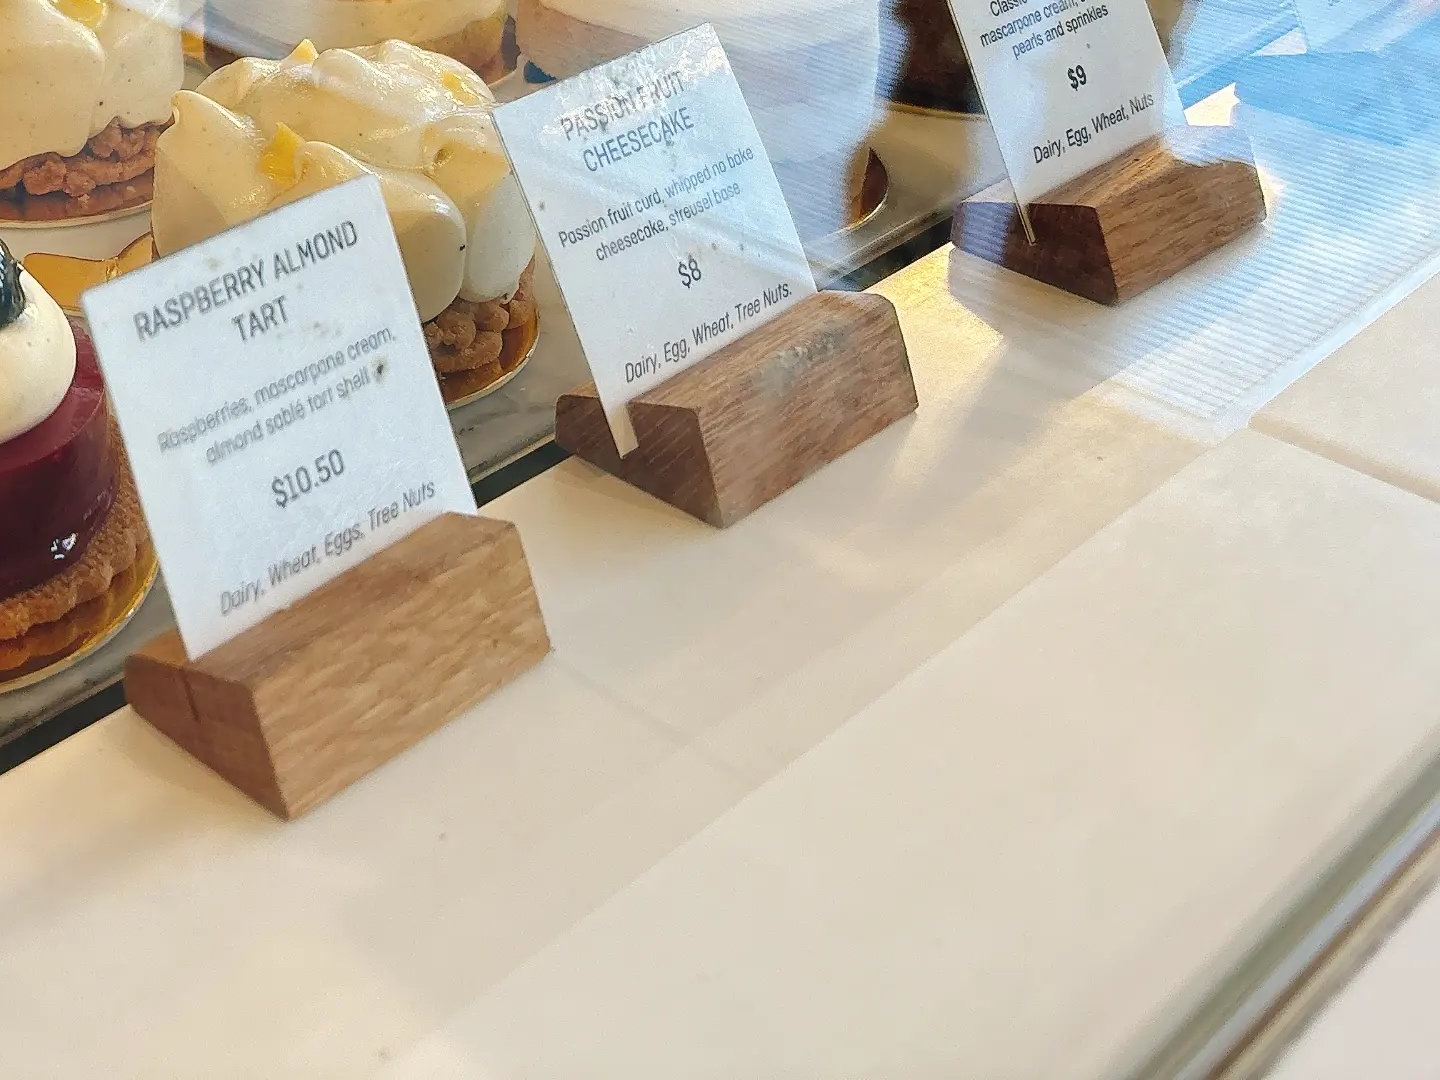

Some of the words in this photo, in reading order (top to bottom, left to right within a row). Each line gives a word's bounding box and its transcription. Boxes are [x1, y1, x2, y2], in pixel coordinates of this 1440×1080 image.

[979, 9, 1042, 48] mascarpone
[1012, 30, 1044, 60] pearls
[1045, 21, 1065, 41] and
[1065, 3, 1109, 36] sprinkles
[1067, 64, 1087, 91] $9
[561, 91, 637, 140] PASSION
[582, 106, 694, 172] CHEESECAKE
[1033, 137, 1065, 164] Dairy,
[1066, 123, 1092, 147] Egg,
[1091, 106, 1130, 135] Wheat,
[1130, 92, 1154, 114] Nuts
[558, 215, 609, 248] Passion
[607, 201, 633, 226] fruit
[635, 189, 665, 212] curd,
[664, 168, 712, 202] whipped
[712, 160, 727, 179] no
[727, 145, 755, 170] bake
[595, 216, 669, 262] cheesecake,
[669, 192, 714, 227] streusel
[714, 181, 741, 206] base
[132, 258, 266, 343] RASPBERRY
[273, 219, 359, 281] ALMOND
[678, 258, 703, 289] $8
[232, 295, 290, 343] TART
[625, 353, 662, 384] Dairy,
[663, 338, 691, 364] Egg,
[692, 312, 735, 345] Wheat,
[734, 299, 761, 325] Tree
[762, 282, 793, 309] Nuts.
[157, 397, 253, 454] Raspberries,
[254, 350, 345, 406] mascarpone
[206, 419, 264, 465] almond
[265, 398, 305, 436] sablé
[307, 386, 334, 412] tart
[336, 366, 371, 398] shell
[271, 448, 345, 510] $10.50
[220, 578, 265, 616] Dairy,
[267, 545, 320, 587] Wheat,
[324, 520, 365, 556] Eggs,
[367, 498, 399, 531] Tree
[402, 480, 436, 513] Nuts
